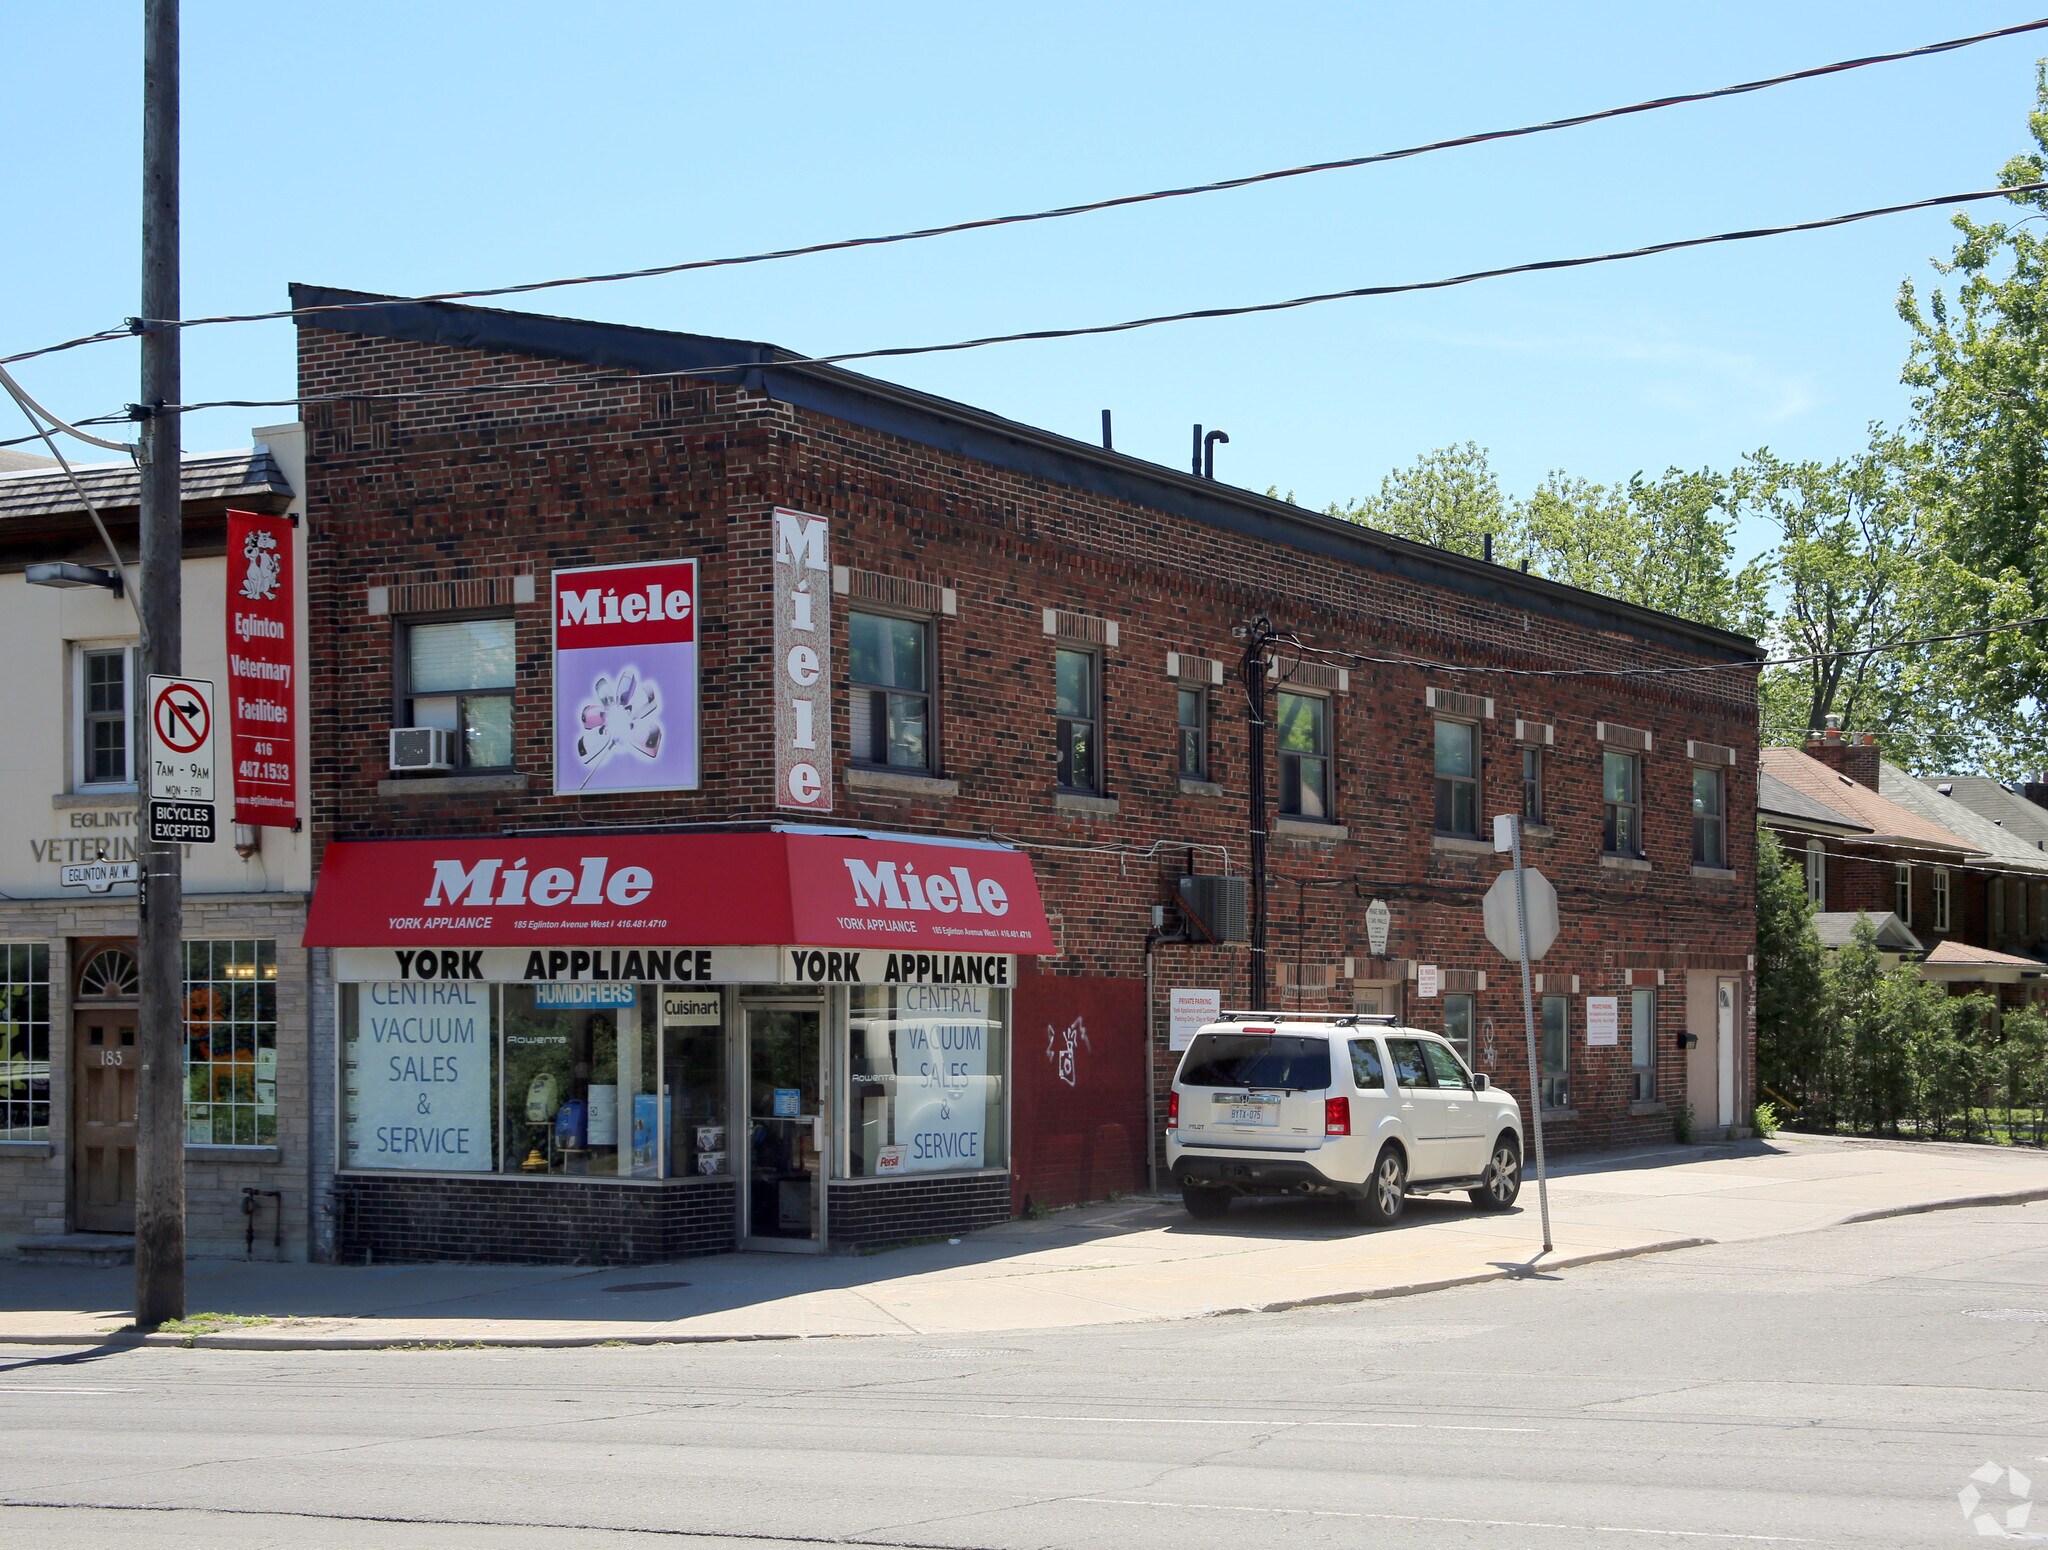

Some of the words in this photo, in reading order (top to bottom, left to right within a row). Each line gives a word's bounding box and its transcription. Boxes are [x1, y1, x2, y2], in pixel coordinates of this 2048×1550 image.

[560, 584, 691, 627] Miele
[235, 612, 285, 642] Eglinton
[776, 515, 829, 804] Miele
[231, 654, 291, 688] Veterinary
[238, 697, 288, 724] Facilities
[255, 742, 272, 756] 416
[155, 761, 174, 776] 7AM
[190, 763, 209, 779] 9AM
[239, 761, 289, 781] 487.1533
[166, 785, 181, 795] MON
[190, 786, 202, 797] FRI
[70, 811, 138, 828] EGLINT
[156, 806, 209, 821] BICYCLES
[155, 824, 210, 838] EXCEPTED
[69, 867, 107, 882] EGLINTON
[109, 866, 120, 879] AV.
[423, 857, 653, 907] Miele
[843, 857, 1009, 916] Miele
[388, 918, 422, 929] YORK
[423, 917, 492, 929] APPLIANCE
[513, 920, 527, 929] 185
[528, 920, 559, 930] Eglinton
[560, 920, 588, 928] Avenue
[590, 920, 609, 928] West
[617, 920, 667, 928] 416.481.4710
[837, 917, 866, 931] YORK
[866, 919, 917, 933] APPLIANCE
[932, 926, 942, 935] 185
[942, 927, 964, 936] Eglinton
[964, 928, 983, 936] Avenue
[983, 929, 996, 937] West
[1001, 930, 1031, 938] 416.481.4710
[395, 950, 484, 979] YORK
[524, 950, 711, 980] APPLIANCE
[791, 951, 861, 982] YORK
[884, 953, 1007, 984] APPLIANCE
[371, 983, 476, 1005] CENTRAL
[536, 983, 633, 1003] HUMIDIFIERS
[906, 986, 981, 1012] CENTRAL
[1179, 997, 1195, 1005] PRIVATE
[664, 999, 718, 1015] Cuisinart
[371, 1018, 474, 1043] VACUUM
[507, 1035, 566, 1044] Rowenta
[908, 1024, 981, 1050] VACUUM
[100, 1051, 122, 1066] 183
[389, 1056, 458, 1083] SALES
[852, 1073, 895, 1082] Rowenta
[920, 1062, 968, 1088] SALES
[417, 1093, 430, 1115] &
[940, 1098, 950, 1120] &
[376, 1127, 469, 1154] SERVICE
[914, 1132, 977, 1159] SERVICE
[880, 1156, 899, 1167] Persil
